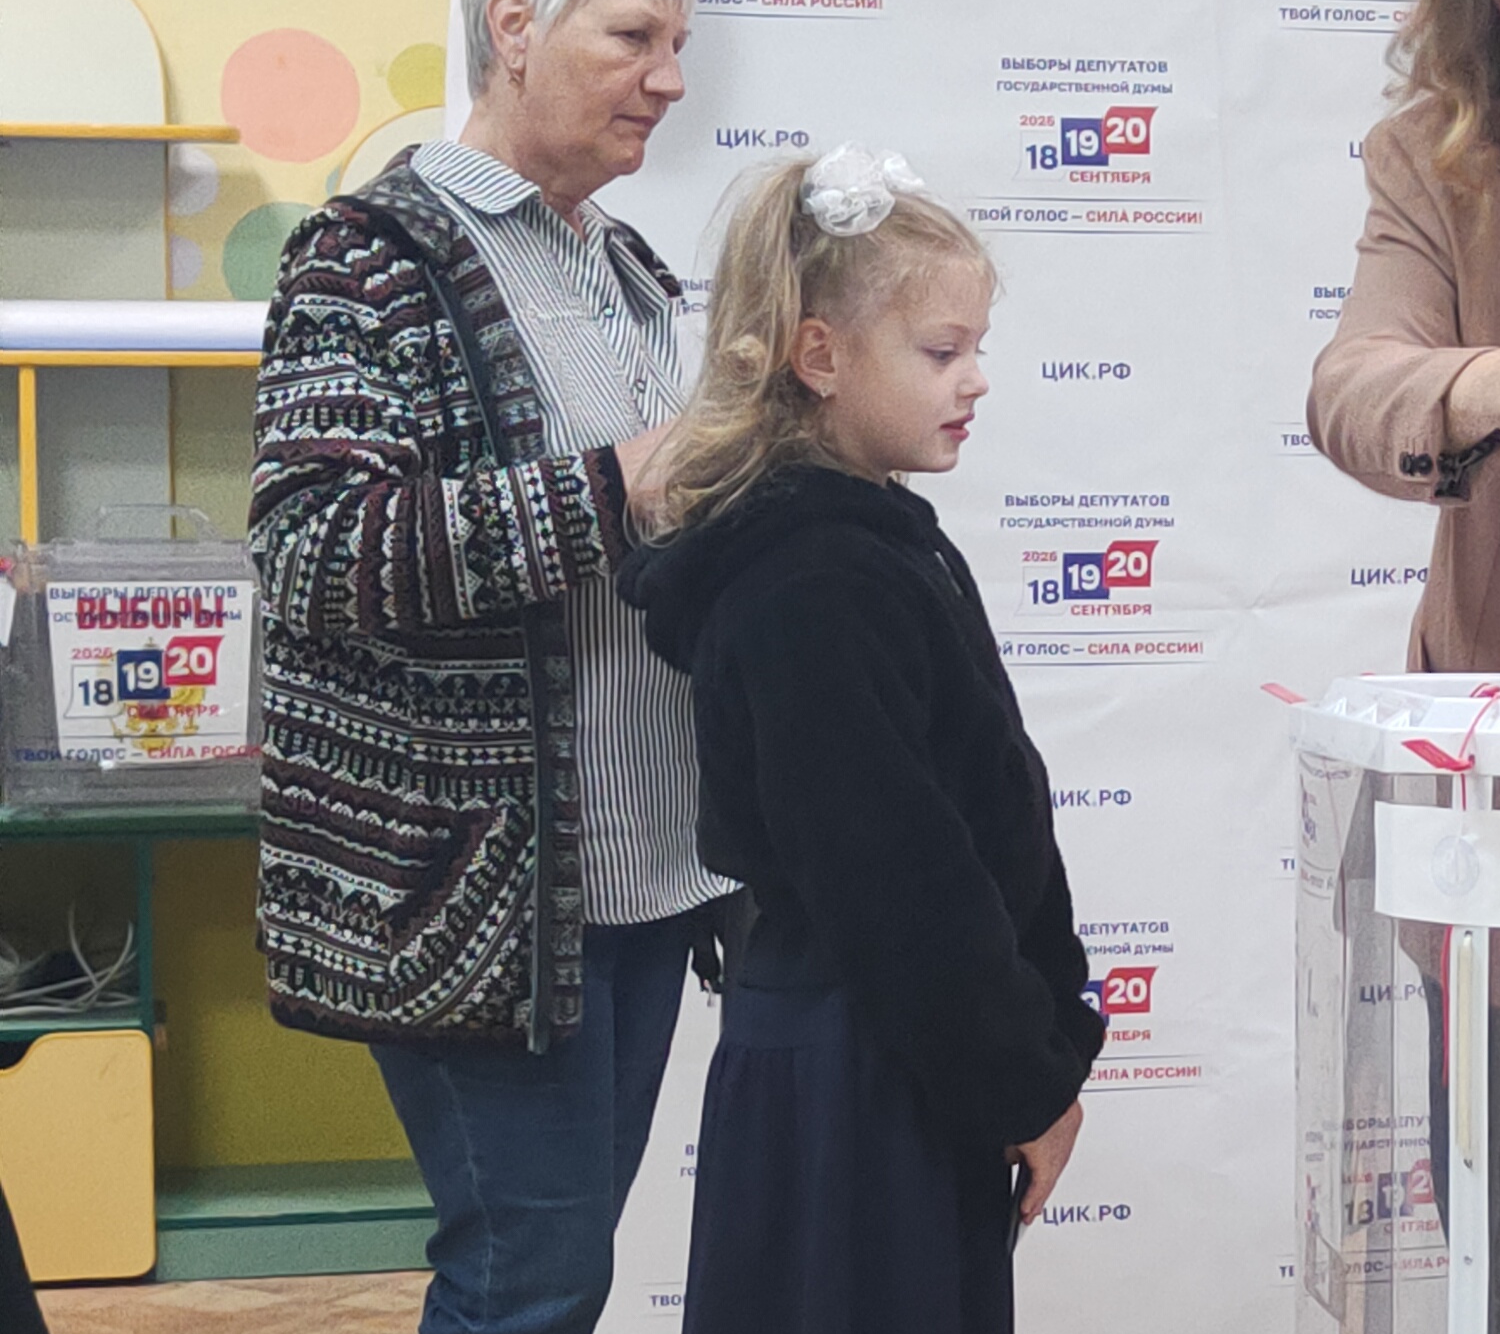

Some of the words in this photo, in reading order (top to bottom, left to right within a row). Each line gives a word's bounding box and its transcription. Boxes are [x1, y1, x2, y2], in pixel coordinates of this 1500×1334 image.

[1279, 5, 1320, 21] ТВОЙ
[1324, 9, 1376, 22] ГОЛОС
[1001, 57, 1071, 72] ВЫБОРЫ
[1075, 59, 1168, 74] ДЕПУТАТОВ
[996, 79, 1129, 95] ГОСУДАРСТВЕННОЙ
[1132, 81, 1173, 95] ДУМЫ
[716, 128, 809, 148] ЦИК.РФ
[1025, 145, 1058, 170] 18
[1065, 130, 1099, 157] 19
[1105, 117, 1147, 144] 20
[1069, 170, 1151, 184] СЕНТЯБРЯ
[968, 206, 1012, 222] ТВОЙ
[1015, 209, 1068, 222] ГОЛОС
[1085, 210, 1129, 224] СИЛА
[1132, 210, 1203, 225] РОССИИ!
[1042, 361, 1131, 381] ЦИК.РФ
[1281, 433, 1311, 446] ТВО
[1005, 494, 1074, 508] ВЫБОРЫ
[1078, 494, 1170, 509] ДЕПУТАТОВ
[1000, 515, 1132, 530] ГОСУДАРСТВЕННОЙ
[1135, 516, 1174, 529] ДУМЫ
[1027, 579, 1060, 605] 18
[1067, 564, 1100, 591] 19
[1107, 550, 1148, 578] 20
[77, 596, 225, 630] ВЫБОРЫ
[1071, 604, 1152, 616] СЕНТЯБРЯ
[1017, 643, 1070, 656] ГОЛОС
[1087, 642, 1131, 656] СИЛА
[1133, 641, 1204, 656] РОССИИ!
[78, 679, 114, 706] 18
[122, 662, 159, 692] 19
[167, 645, 213, 677] 20
[1078, 921, 1170, 937] ДЕПУТАТОВ
[1134, 942, 1174, 956] ДУМЫ
[1107, 976, 1148, 1005] 20
[1133, 1064, 1202, 1080] РОССИИ!
[1043, 1204, 1132, 1225] ЦИК.РФ
[650, 1294, 684, 1307] ТВО
